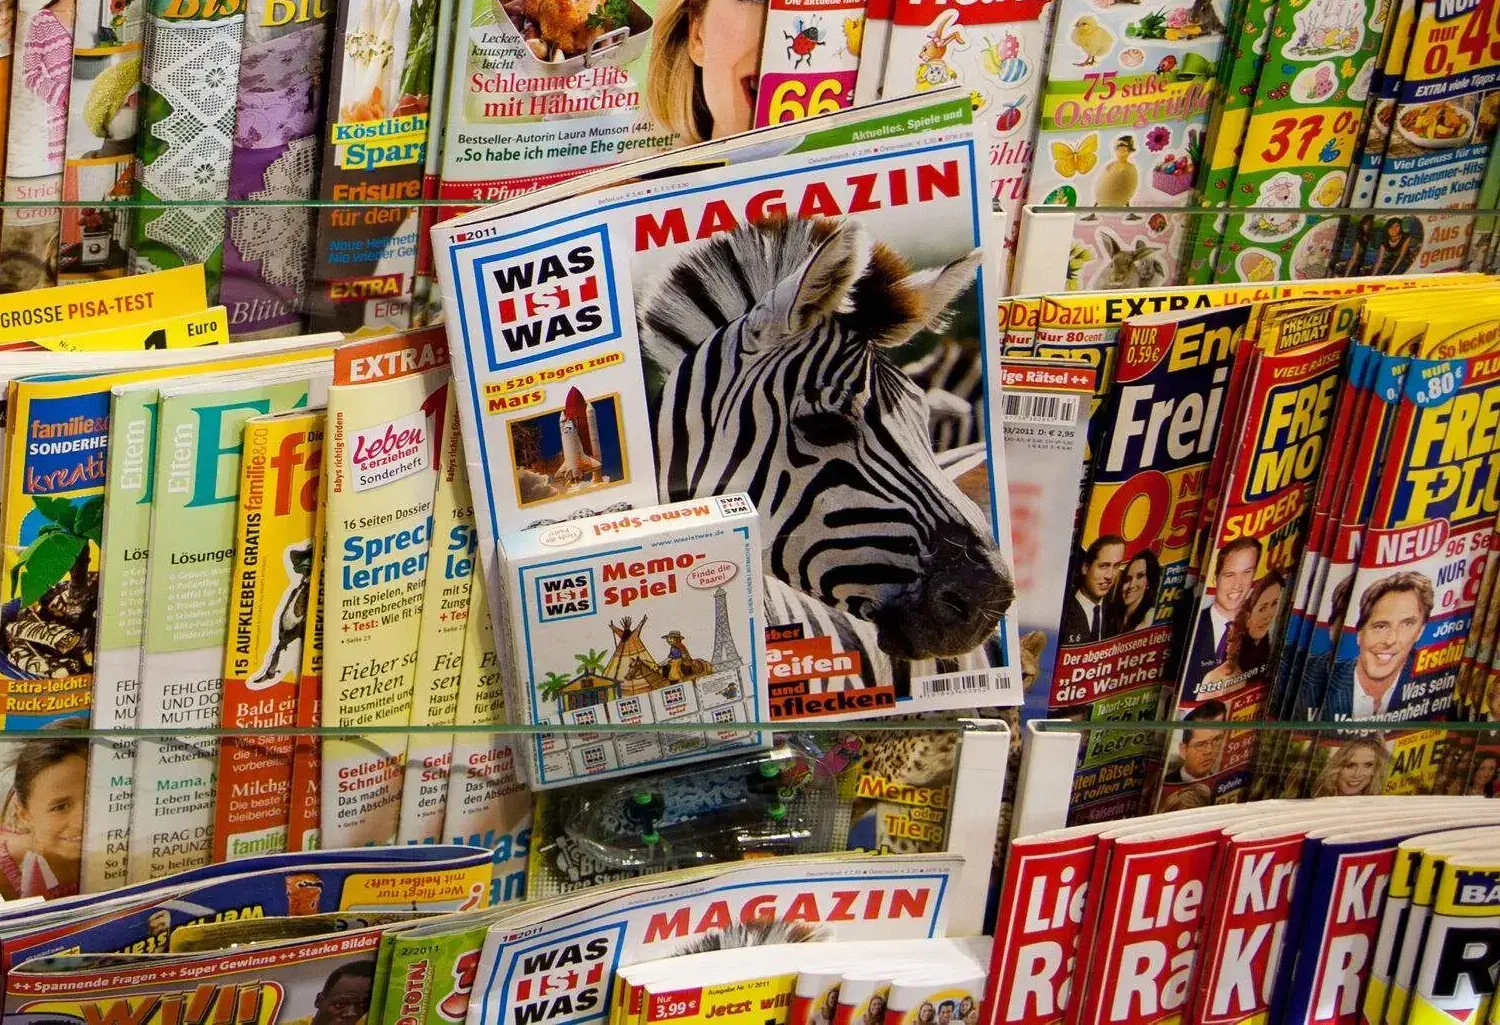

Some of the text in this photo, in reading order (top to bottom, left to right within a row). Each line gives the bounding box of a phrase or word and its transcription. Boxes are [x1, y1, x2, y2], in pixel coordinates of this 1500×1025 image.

[471, 67, 628, 94] Schlemmer-Hits
[1082, 73, 1167, 101] 75 süße
[484, 89, 640, 117] mit Hähnchen
[458, 121, 654, 144] Bestseller-Autorin Laura Munson (44):
[635, 160, 962, 252] MAGAZIN
[493, 244, 595, 293] WAS
[0, 306, 64, 330] GROSSE
[68, 293, 154, 320] PISA-TEST
[187, 318, 219, 337] Euro
[501, 304, 603, 352] WAS
[488, 389, 543, 411] Mars
[1225, 491, 1298, 541] SUPER
[1376, 523, 1443, 565] NEU!
[602, 552, 706, 582] Memo-
[604, 574, 678, 607] Spiel
[643, 888, 930, 944] MAGAZIN
[35, 954, 275, 994] Spannende Fragen Super Gewinne
